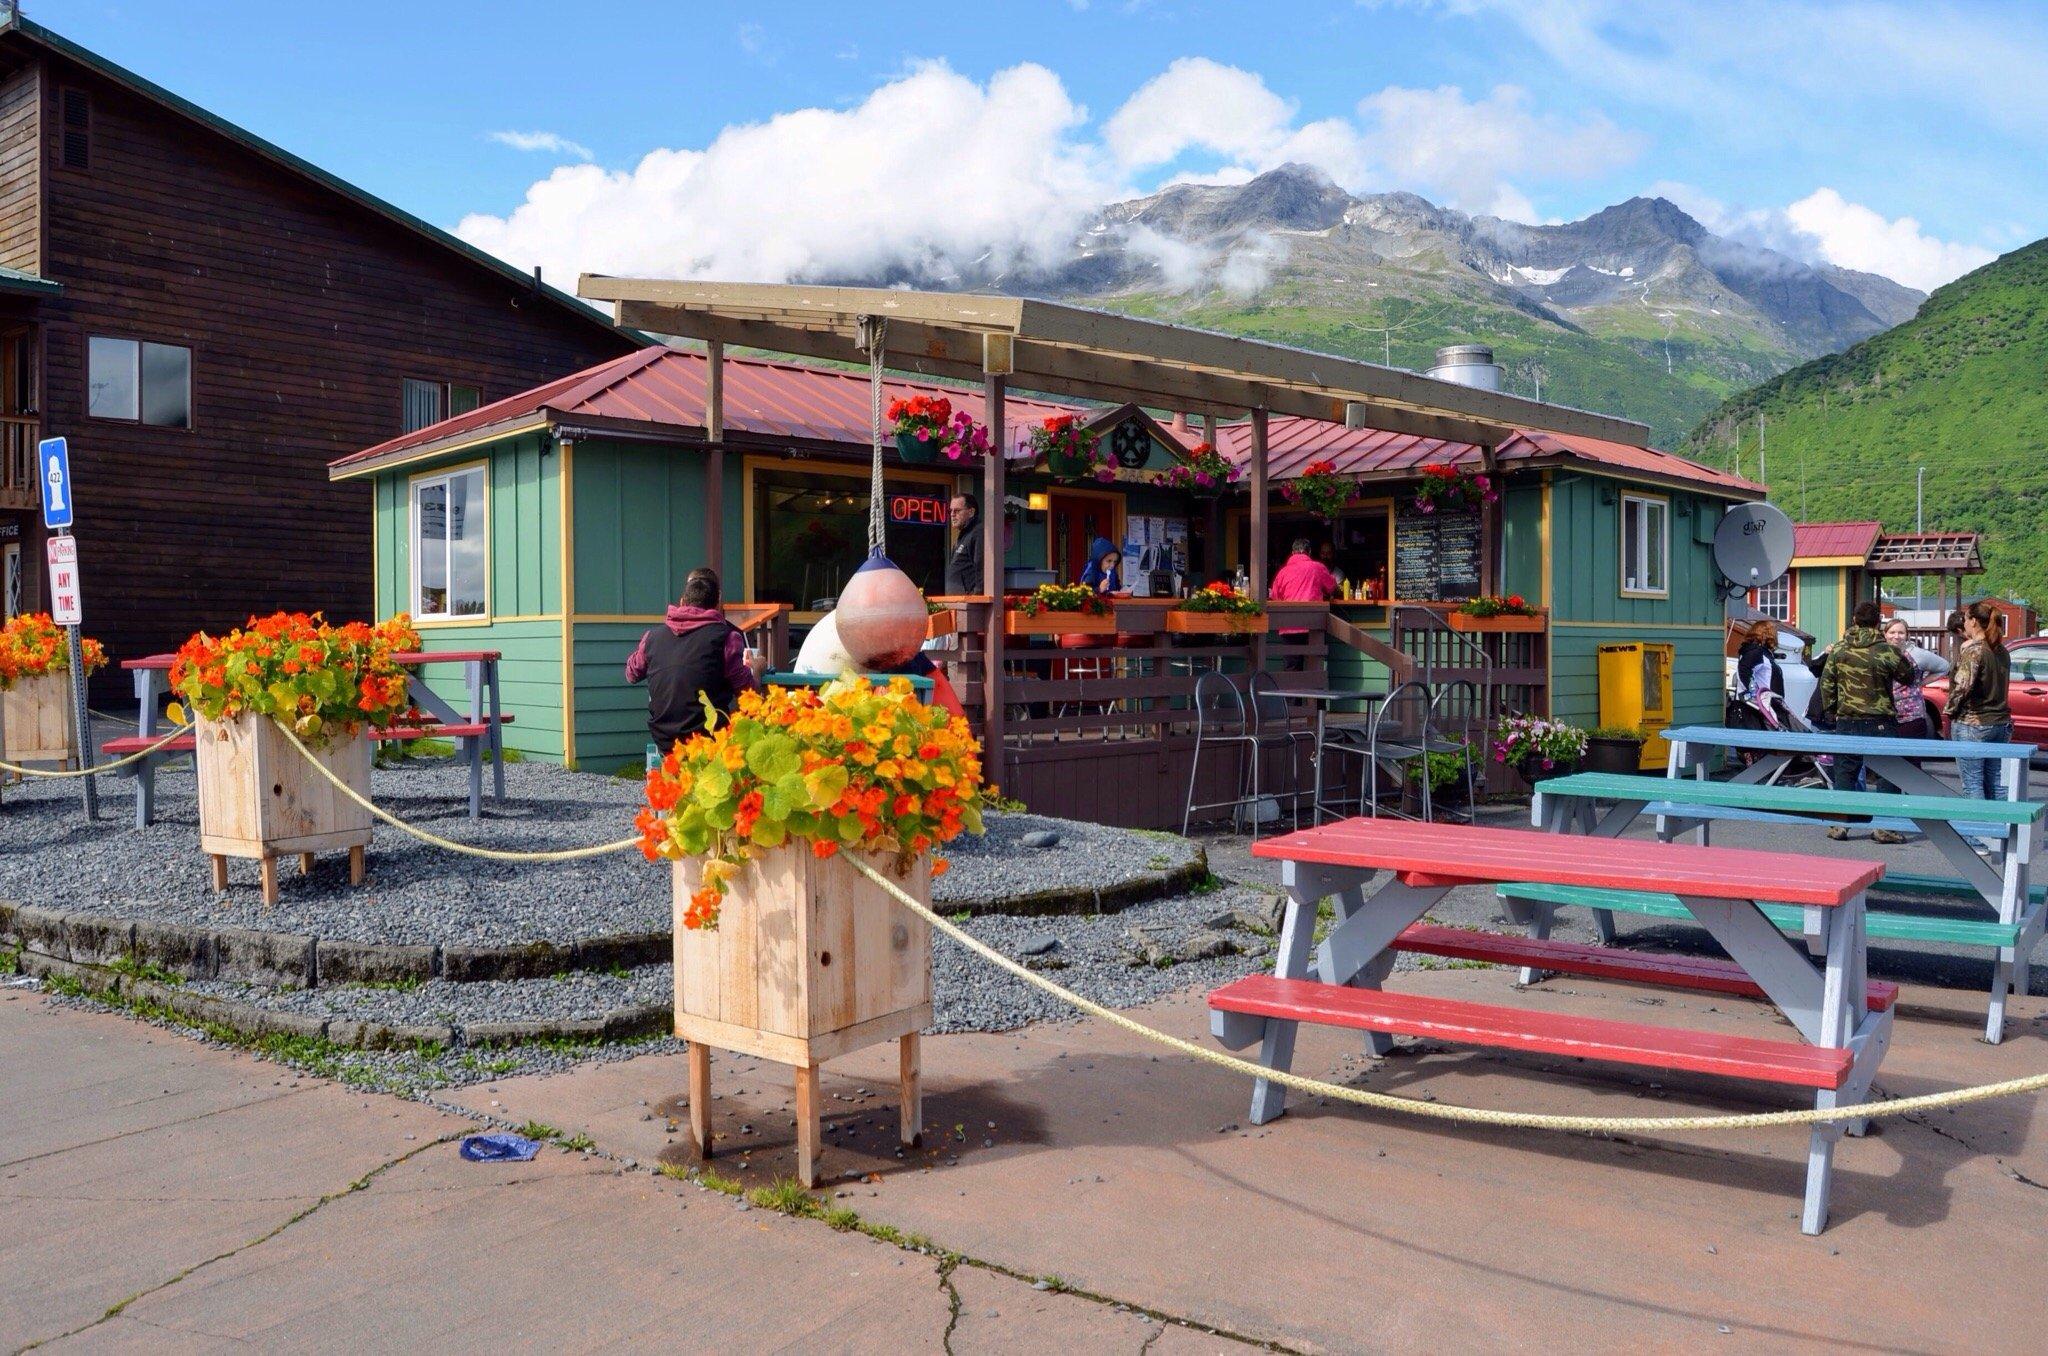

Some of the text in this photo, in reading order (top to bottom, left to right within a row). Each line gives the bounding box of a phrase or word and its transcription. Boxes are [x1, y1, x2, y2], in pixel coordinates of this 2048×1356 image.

[50, 472, 61, 483] 422
[893, 498, 947, 523] OPEN
[1743, 520, 1766, 534] dish
[58, 572, 71, 588] ANY
[58, 596, 74, 611] TIME
[1600, 645, 1638, 653] NEWS
